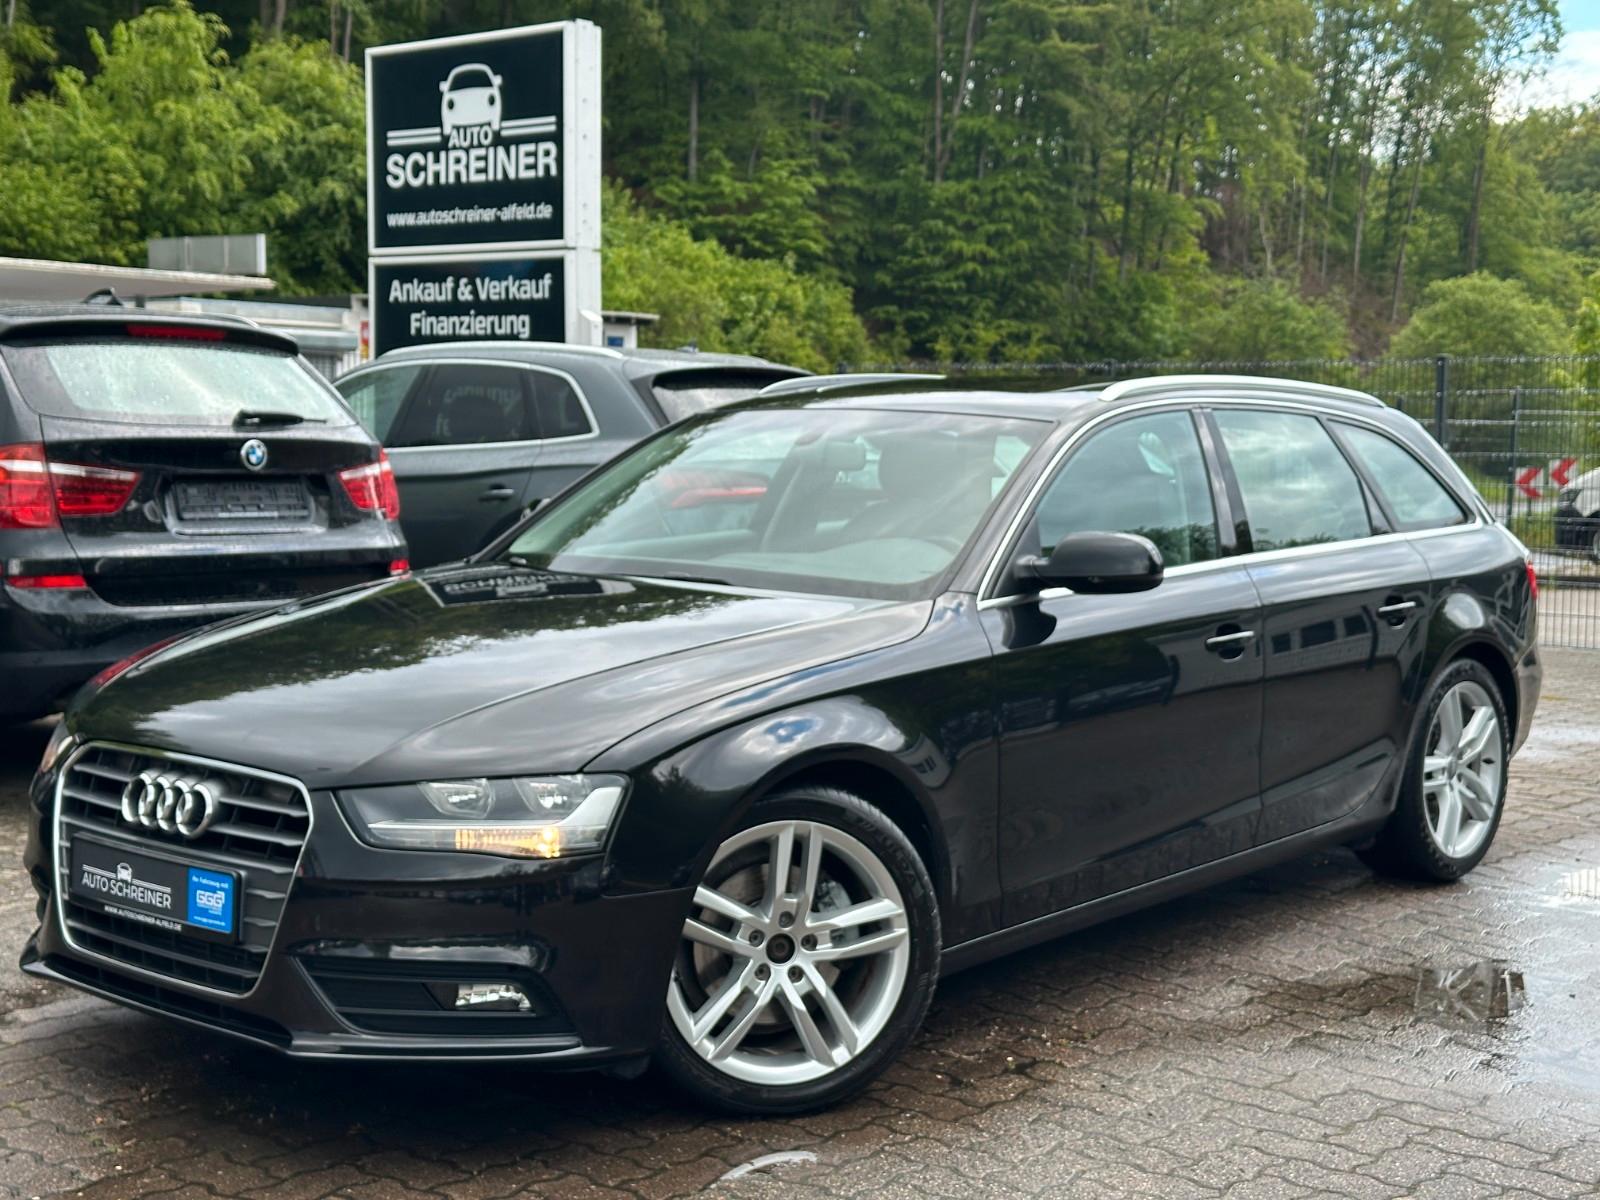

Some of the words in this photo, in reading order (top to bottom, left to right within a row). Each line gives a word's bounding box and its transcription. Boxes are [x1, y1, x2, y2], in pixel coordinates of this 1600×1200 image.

[448, 125, 493, 149] AUTO
[386, 140, 558, 189] SCHREINER
[386, 202, 553, 228] www.autoschreiner-alfeld.de
[388, 275, 454, 303] Ankauf
[456, 276, 473, 301] &
[475, 272, 552, 301] Verkauf
[410, 309, 530, 339] Finanzierung
[82, 872, 108, 892] AUTO
[109, 881, 172, 908] SCHREINER
